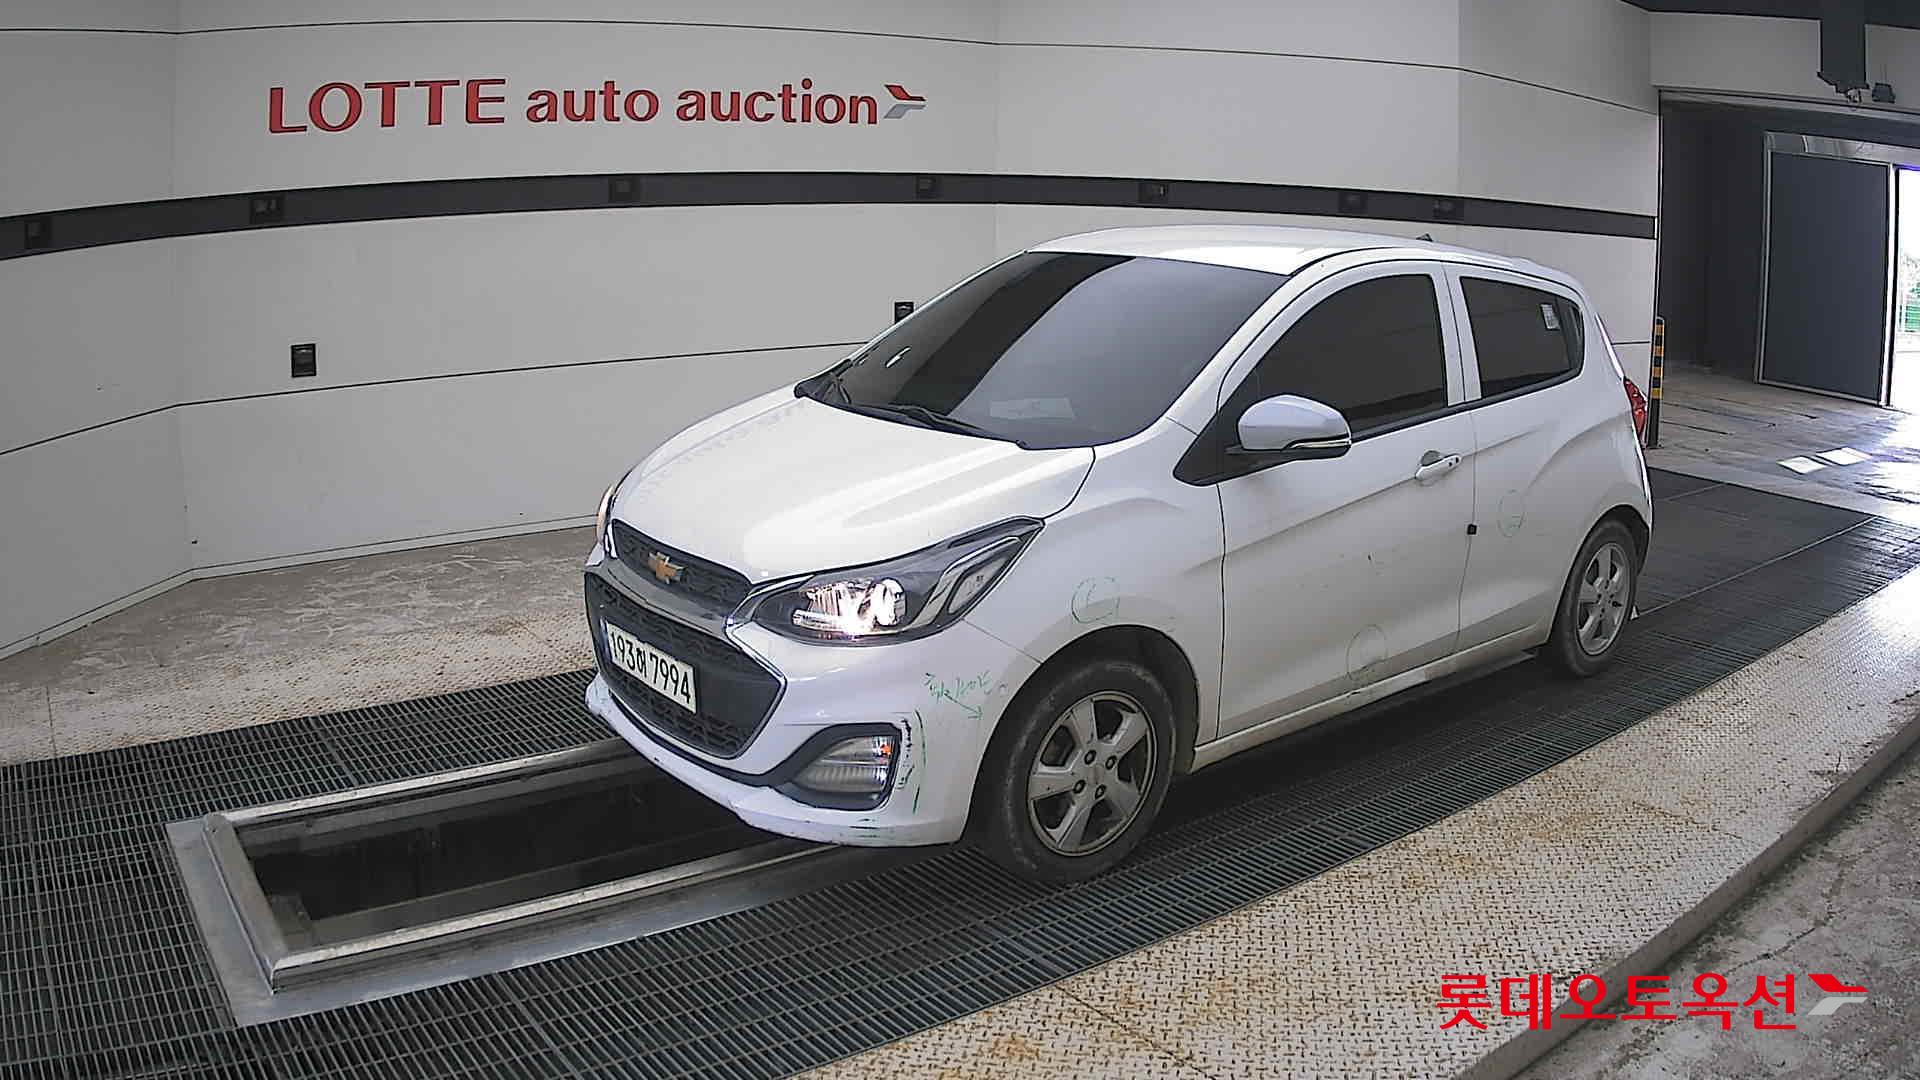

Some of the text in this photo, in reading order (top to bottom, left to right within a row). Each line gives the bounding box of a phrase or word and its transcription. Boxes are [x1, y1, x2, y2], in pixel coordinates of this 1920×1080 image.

[268, 78, 878, 133] LOTTE auto auction
